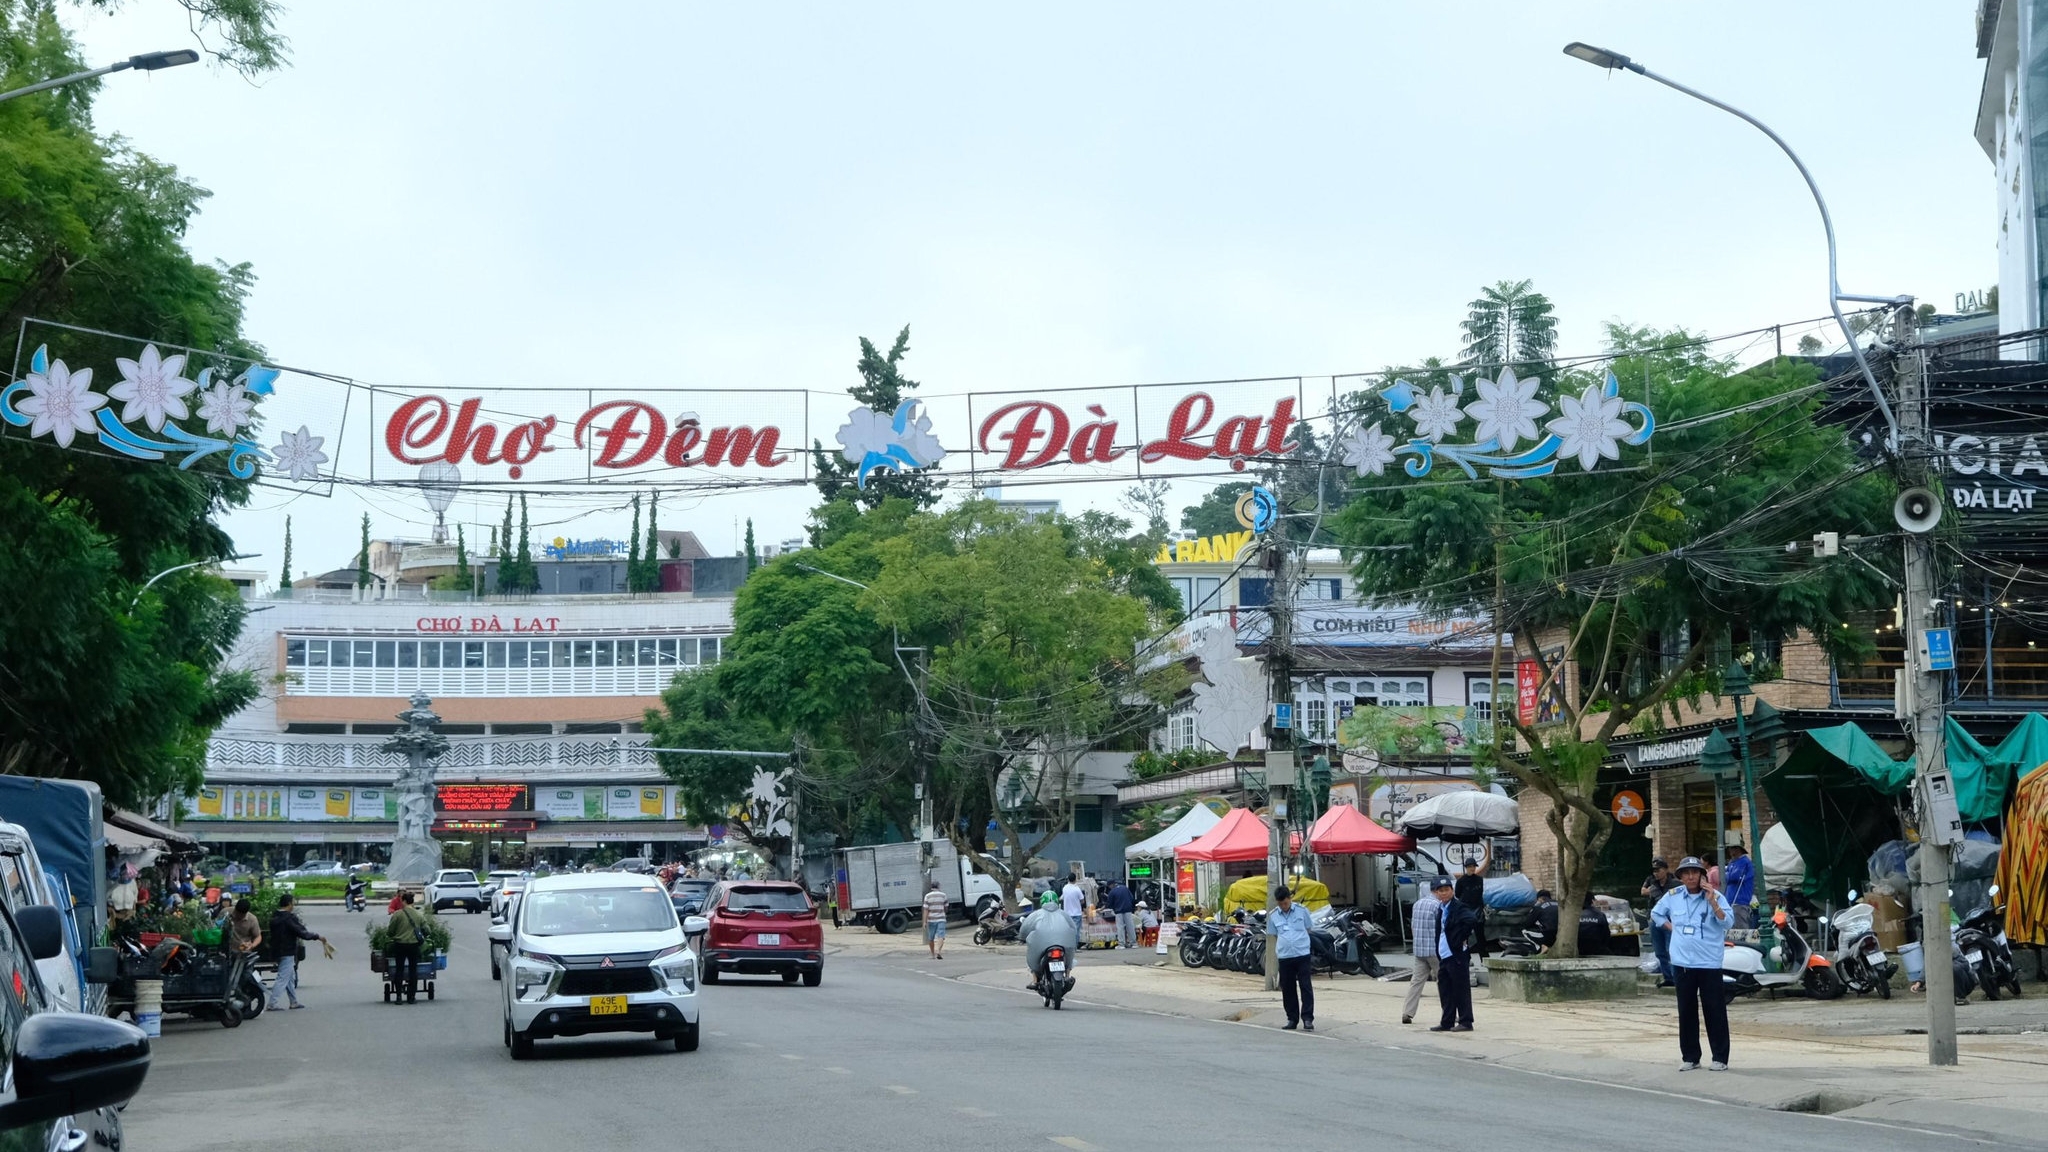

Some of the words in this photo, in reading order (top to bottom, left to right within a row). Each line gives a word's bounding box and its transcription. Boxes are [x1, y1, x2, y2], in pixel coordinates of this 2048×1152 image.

[385, 395, 558, 480] Chợ
[574, 398, 789, 470] Đêm
[979, 400, 1126, 471] Đà
[1139, 391, 1300, 473] Lạt
[1953, 481, 1988, 508] ĐÀ
[1993, 488, 2036, 513] LẠT
[1176, 530, 1253, 563] BANK
[417, 615, 462, 634] CHỢ
[471, 614, 502, 632] ĐÀ
[513, 617, 560, 634] LẠT
[1313, 617, 1355, 633] CƠM
[601, 997, 617, 1005] 49E
